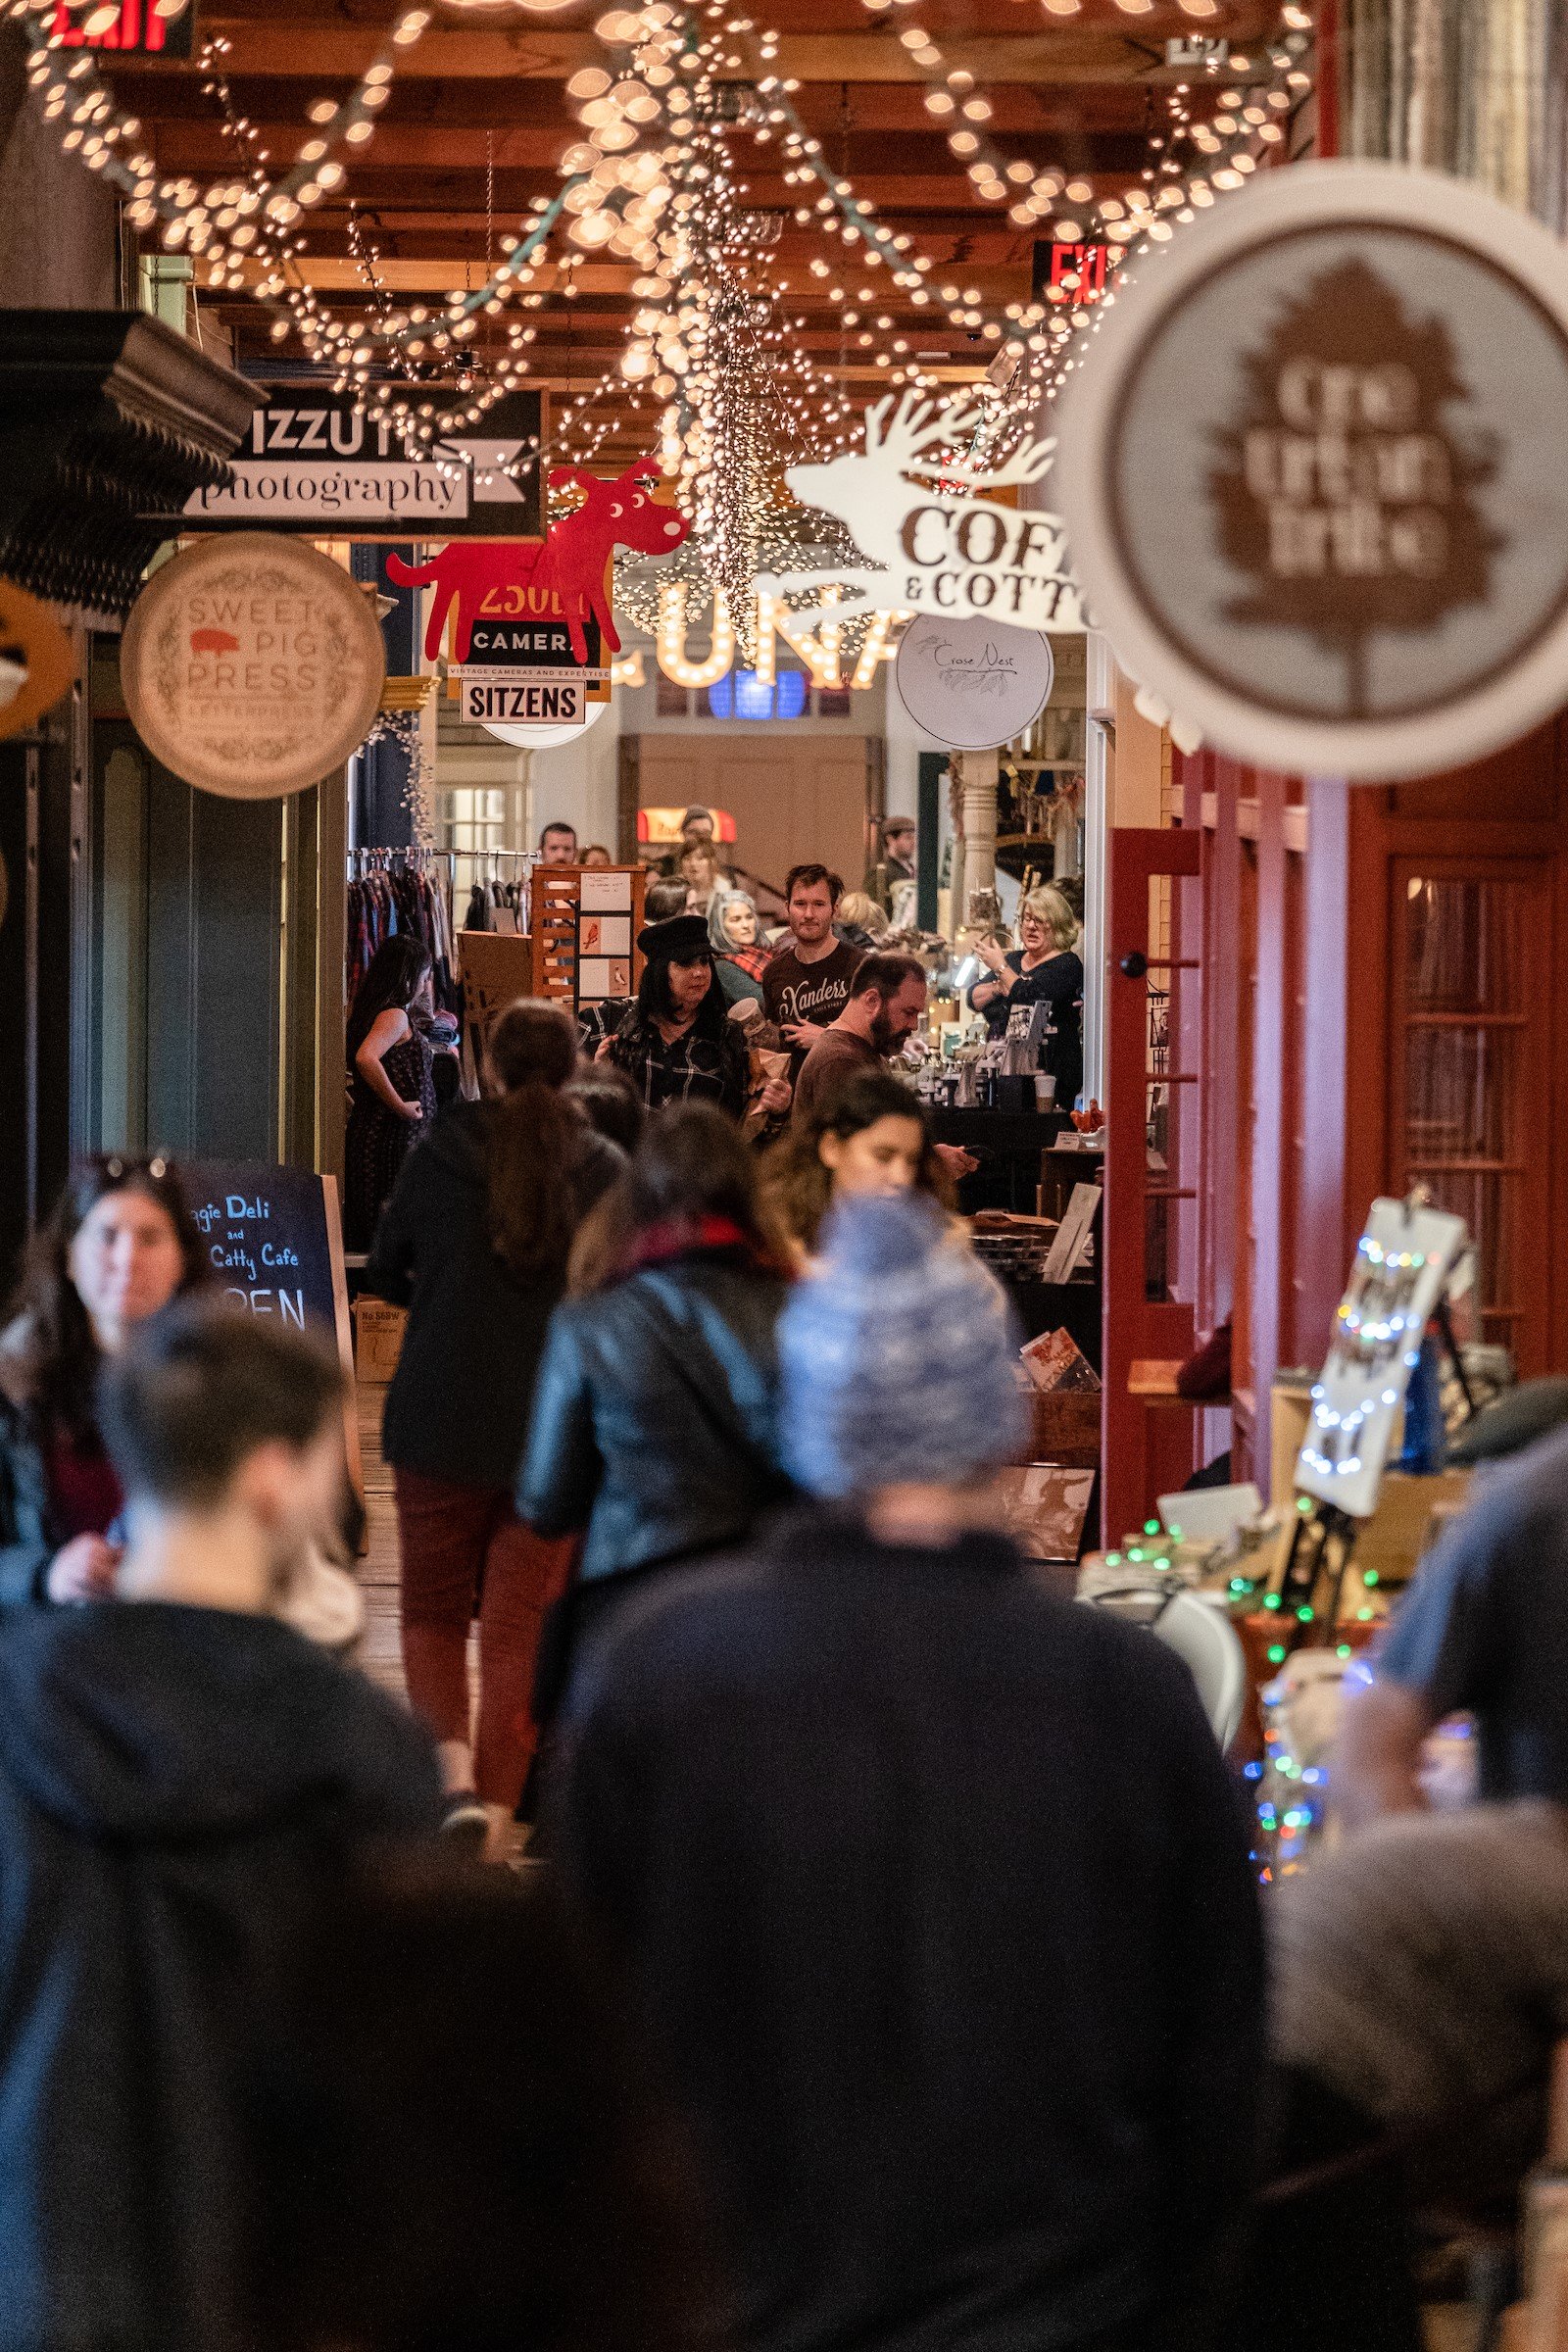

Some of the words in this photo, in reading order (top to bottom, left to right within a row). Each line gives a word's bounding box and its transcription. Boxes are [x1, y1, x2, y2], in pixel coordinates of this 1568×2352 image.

[1051, 244, 1126, 304] EXI
[899, 506, 1071, 576] COF
[188, 599, 313, 625] SWEET
[256, 630, 316, 657] PIG
[473, 632, 576, 651] CAMER
[188, 662, 316, 692] PRESS
[559, 669, 610, 678] EXPERTISE
[469, 687, 576, 717] SITZENS
[225, 1195, 270, 1219] Deli
[227, 1229, 244, 1240] and
[210, 1245, 257, 1281] Catty
[261, 1243, 299, 1266] Cafe
